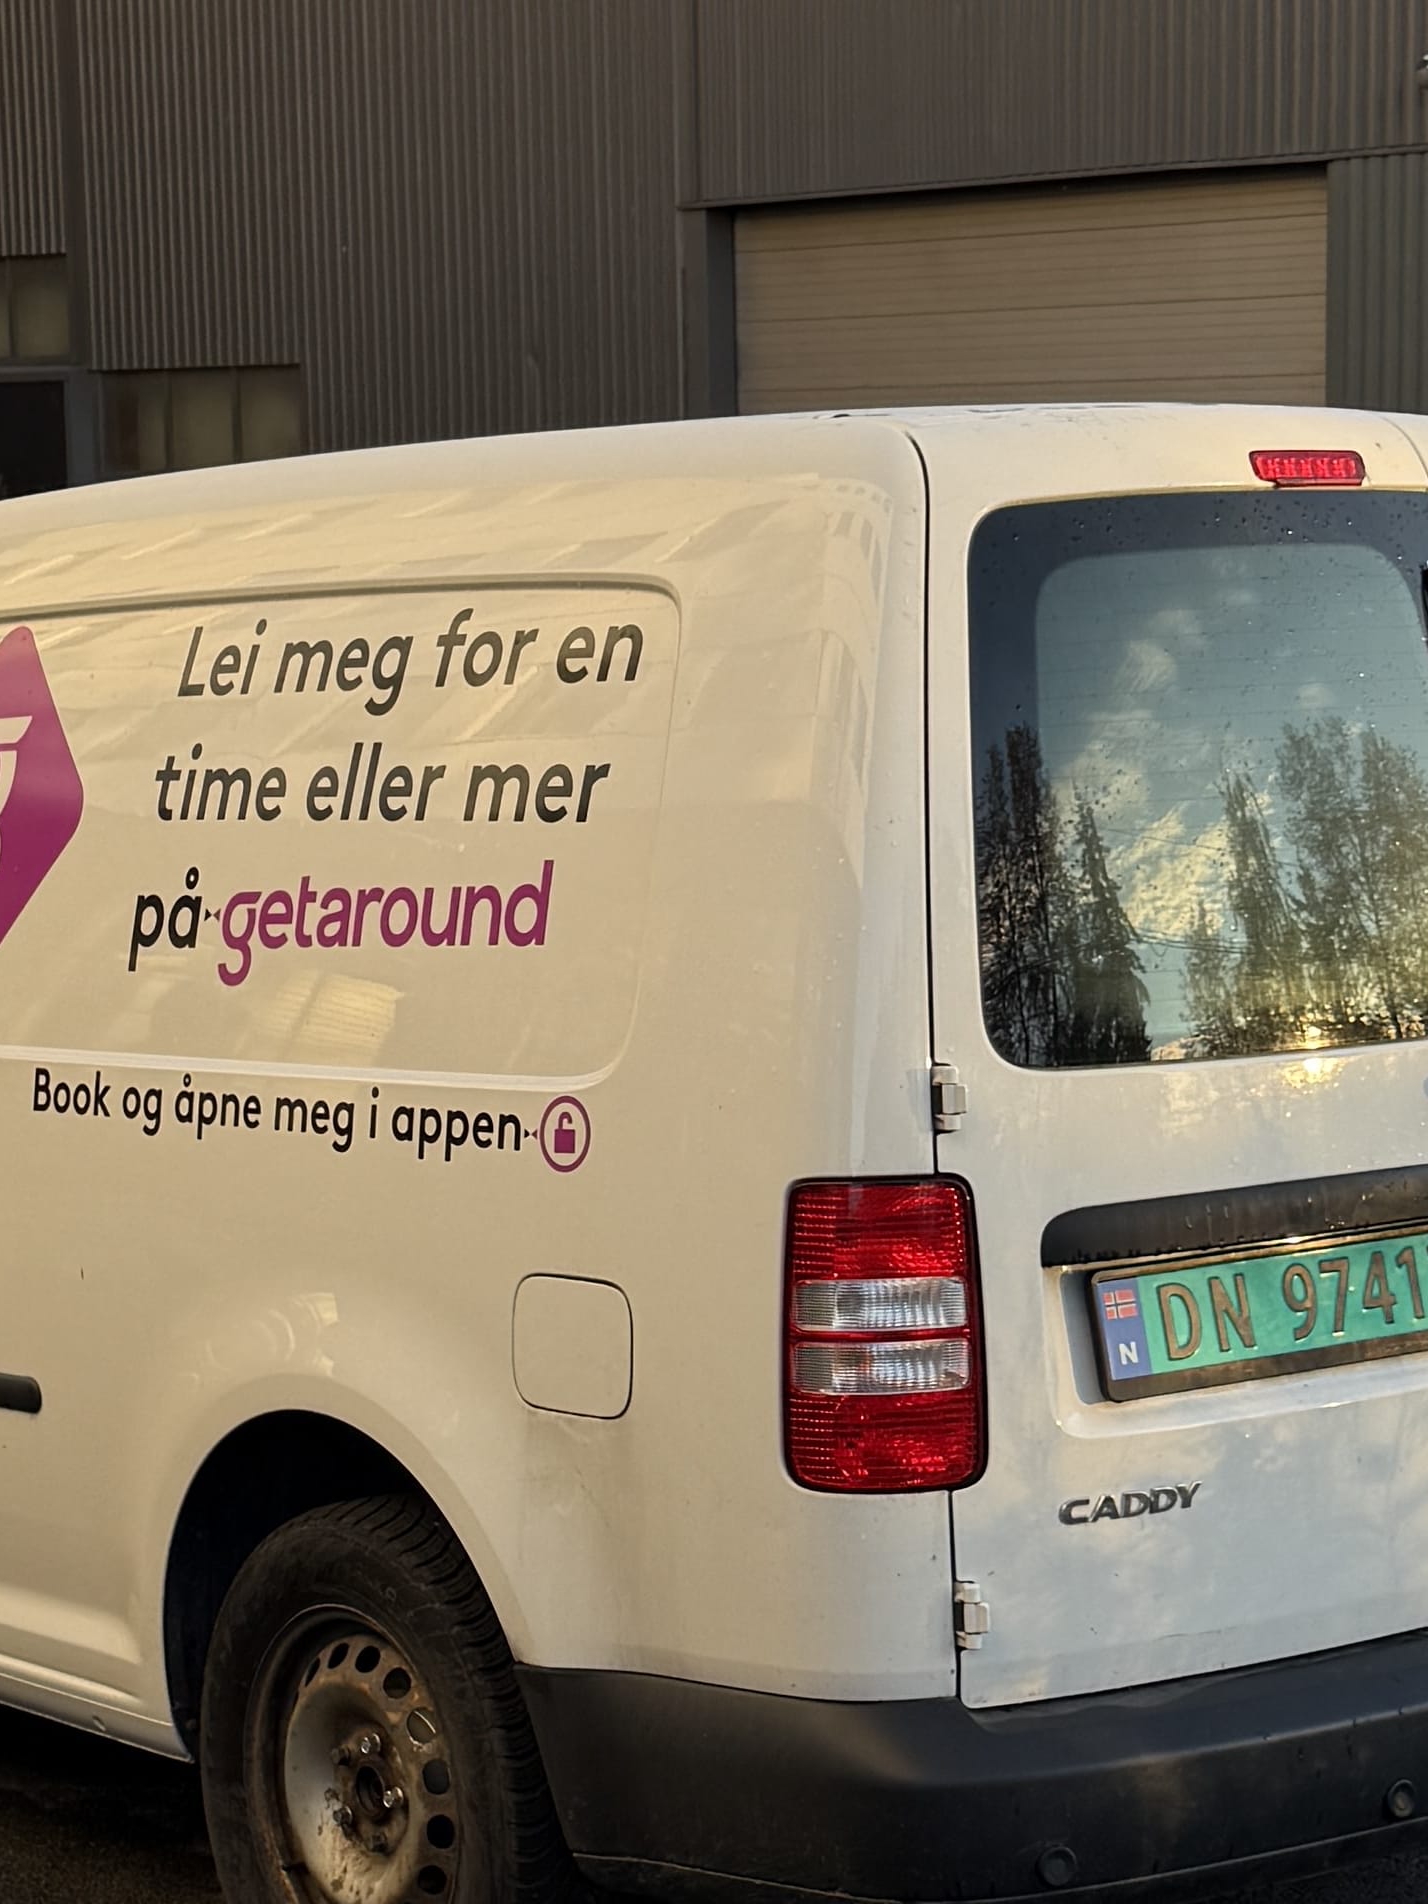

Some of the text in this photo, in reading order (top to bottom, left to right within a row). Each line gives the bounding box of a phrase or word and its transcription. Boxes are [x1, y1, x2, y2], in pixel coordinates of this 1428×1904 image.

[178, 608, 644, 716] Lei meg for en
[154, 742, 610, 823] time eller mer
[128, 860, 555, 987] på getaround
[32, 1068, 523, 1162] Book og åpne meg i appen
[1118, 1341, 1138, 1365] N
[1156, 1274, 1257, 1361] DN
[1059, 1482, 1202, 1526] CADDY
